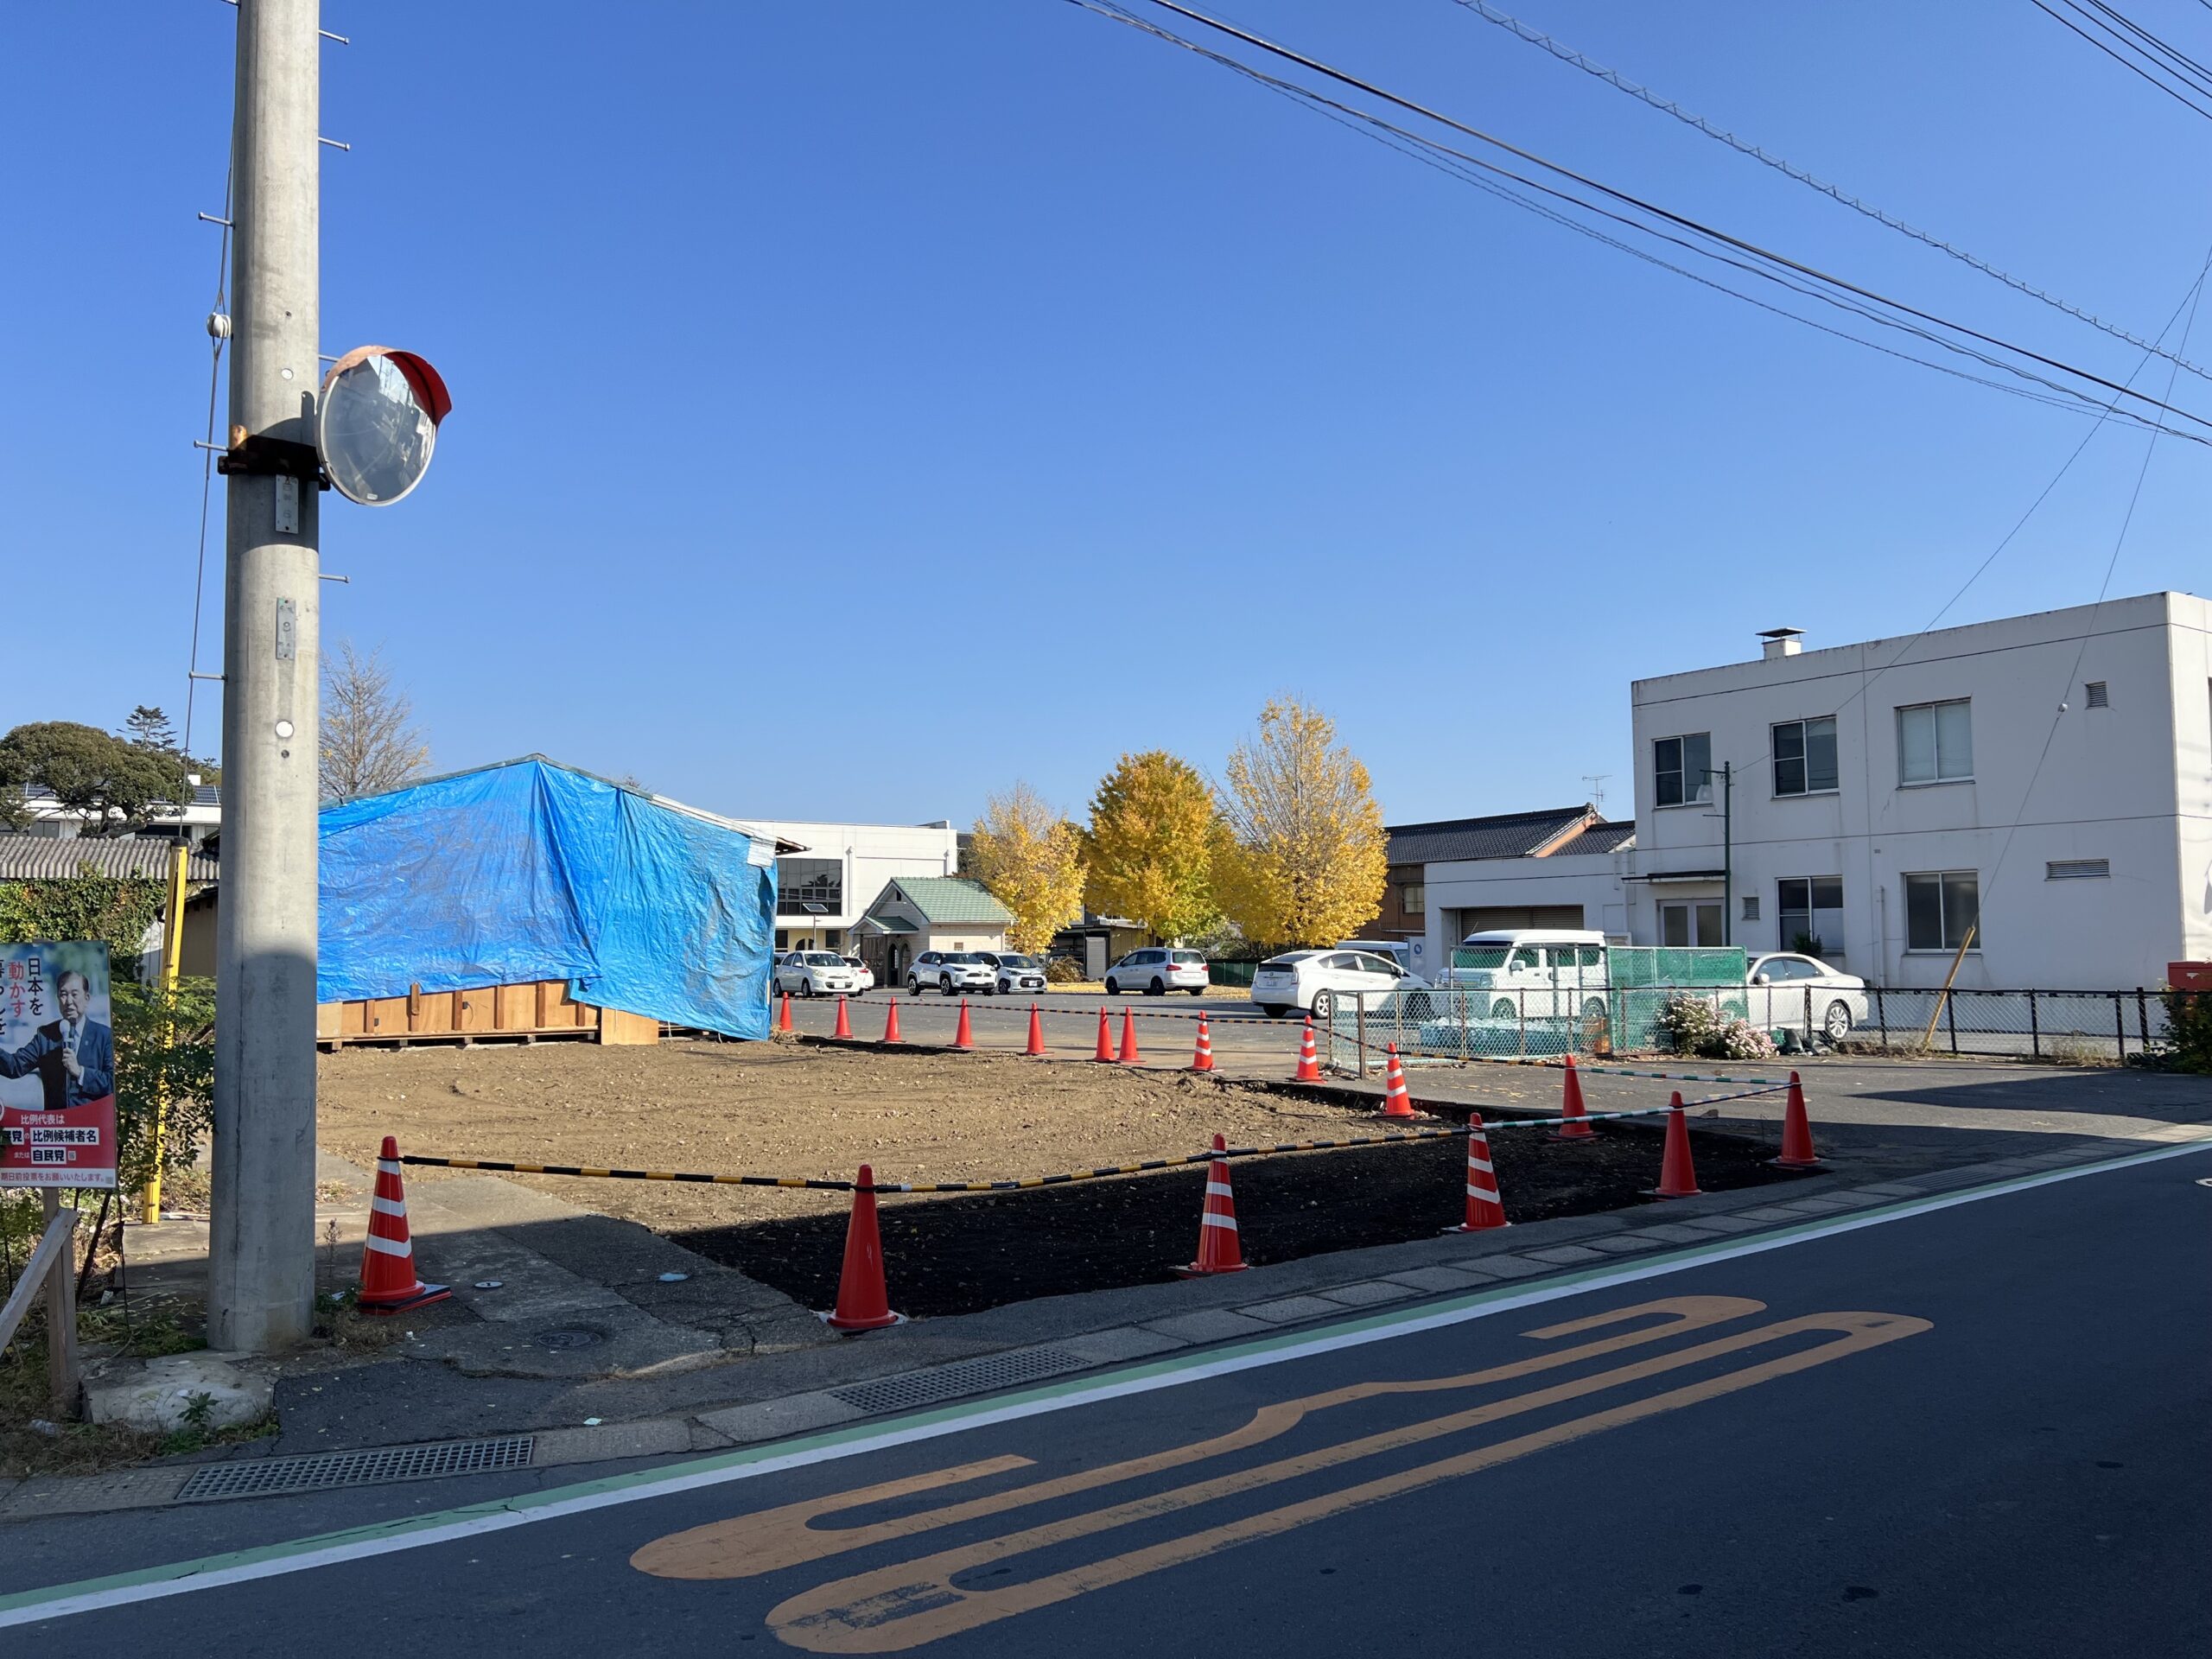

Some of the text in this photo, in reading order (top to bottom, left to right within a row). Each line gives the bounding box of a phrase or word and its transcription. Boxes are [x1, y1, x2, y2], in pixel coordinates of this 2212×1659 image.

[9, 962, 25, 1017] 動かす
[28, 957, 43, 1015] 日本を
[21, 1115, 65, 1125] 比例代表は
